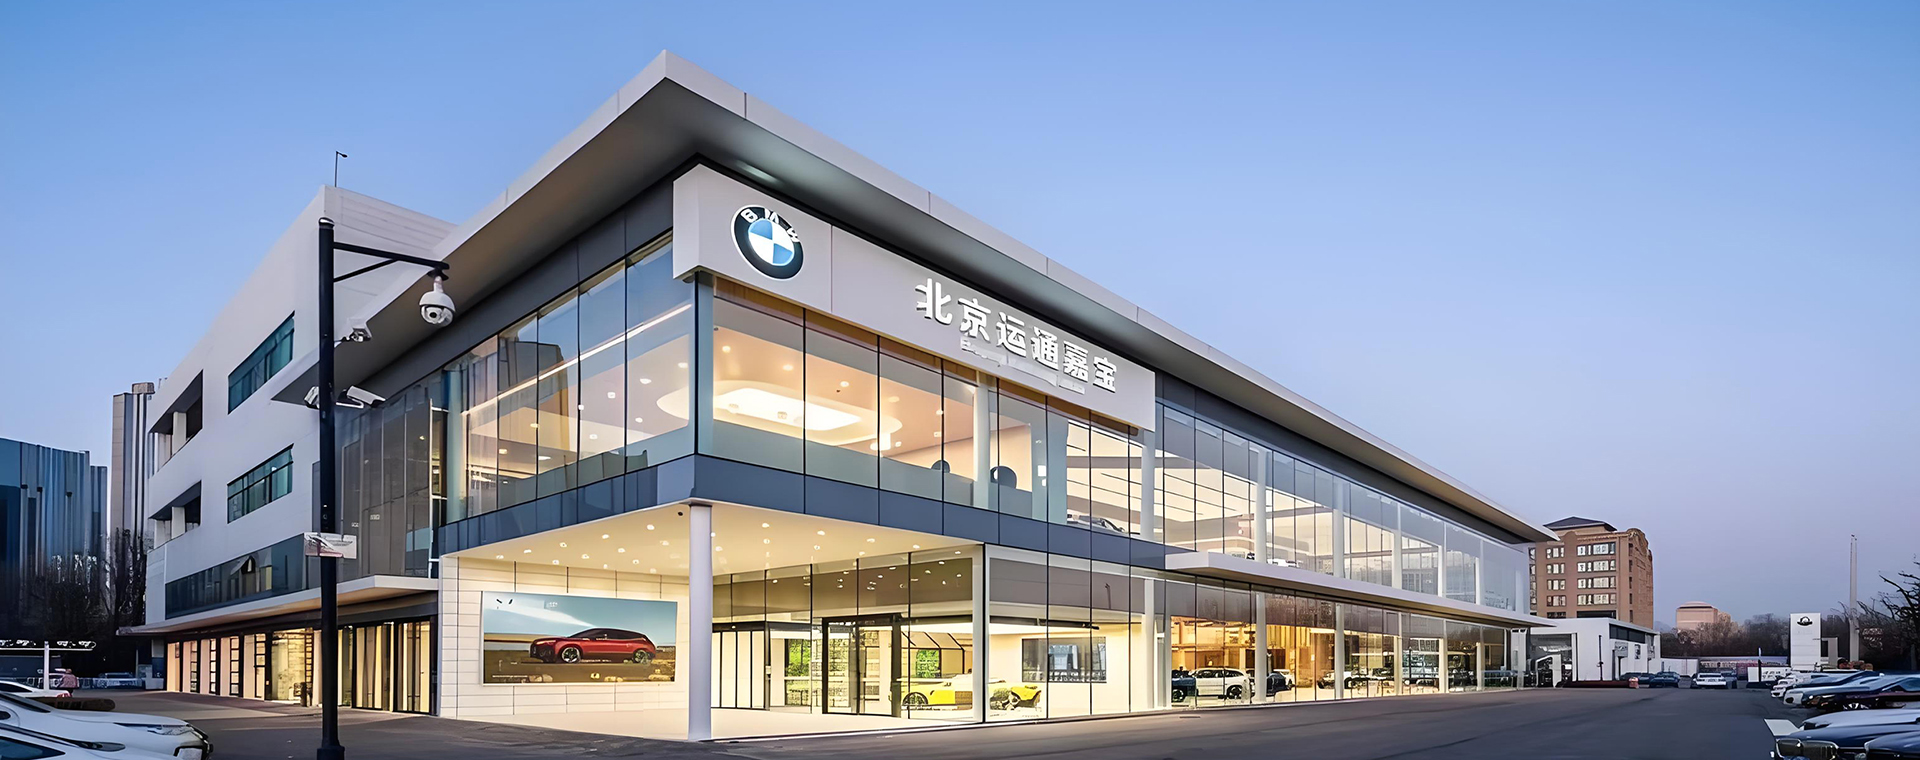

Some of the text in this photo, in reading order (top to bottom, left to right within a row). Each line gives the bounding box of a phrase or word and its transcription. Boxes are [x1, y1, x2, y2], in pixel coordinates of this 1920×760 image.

[915, 278, 1117, 393] 北京运通嘉宝
